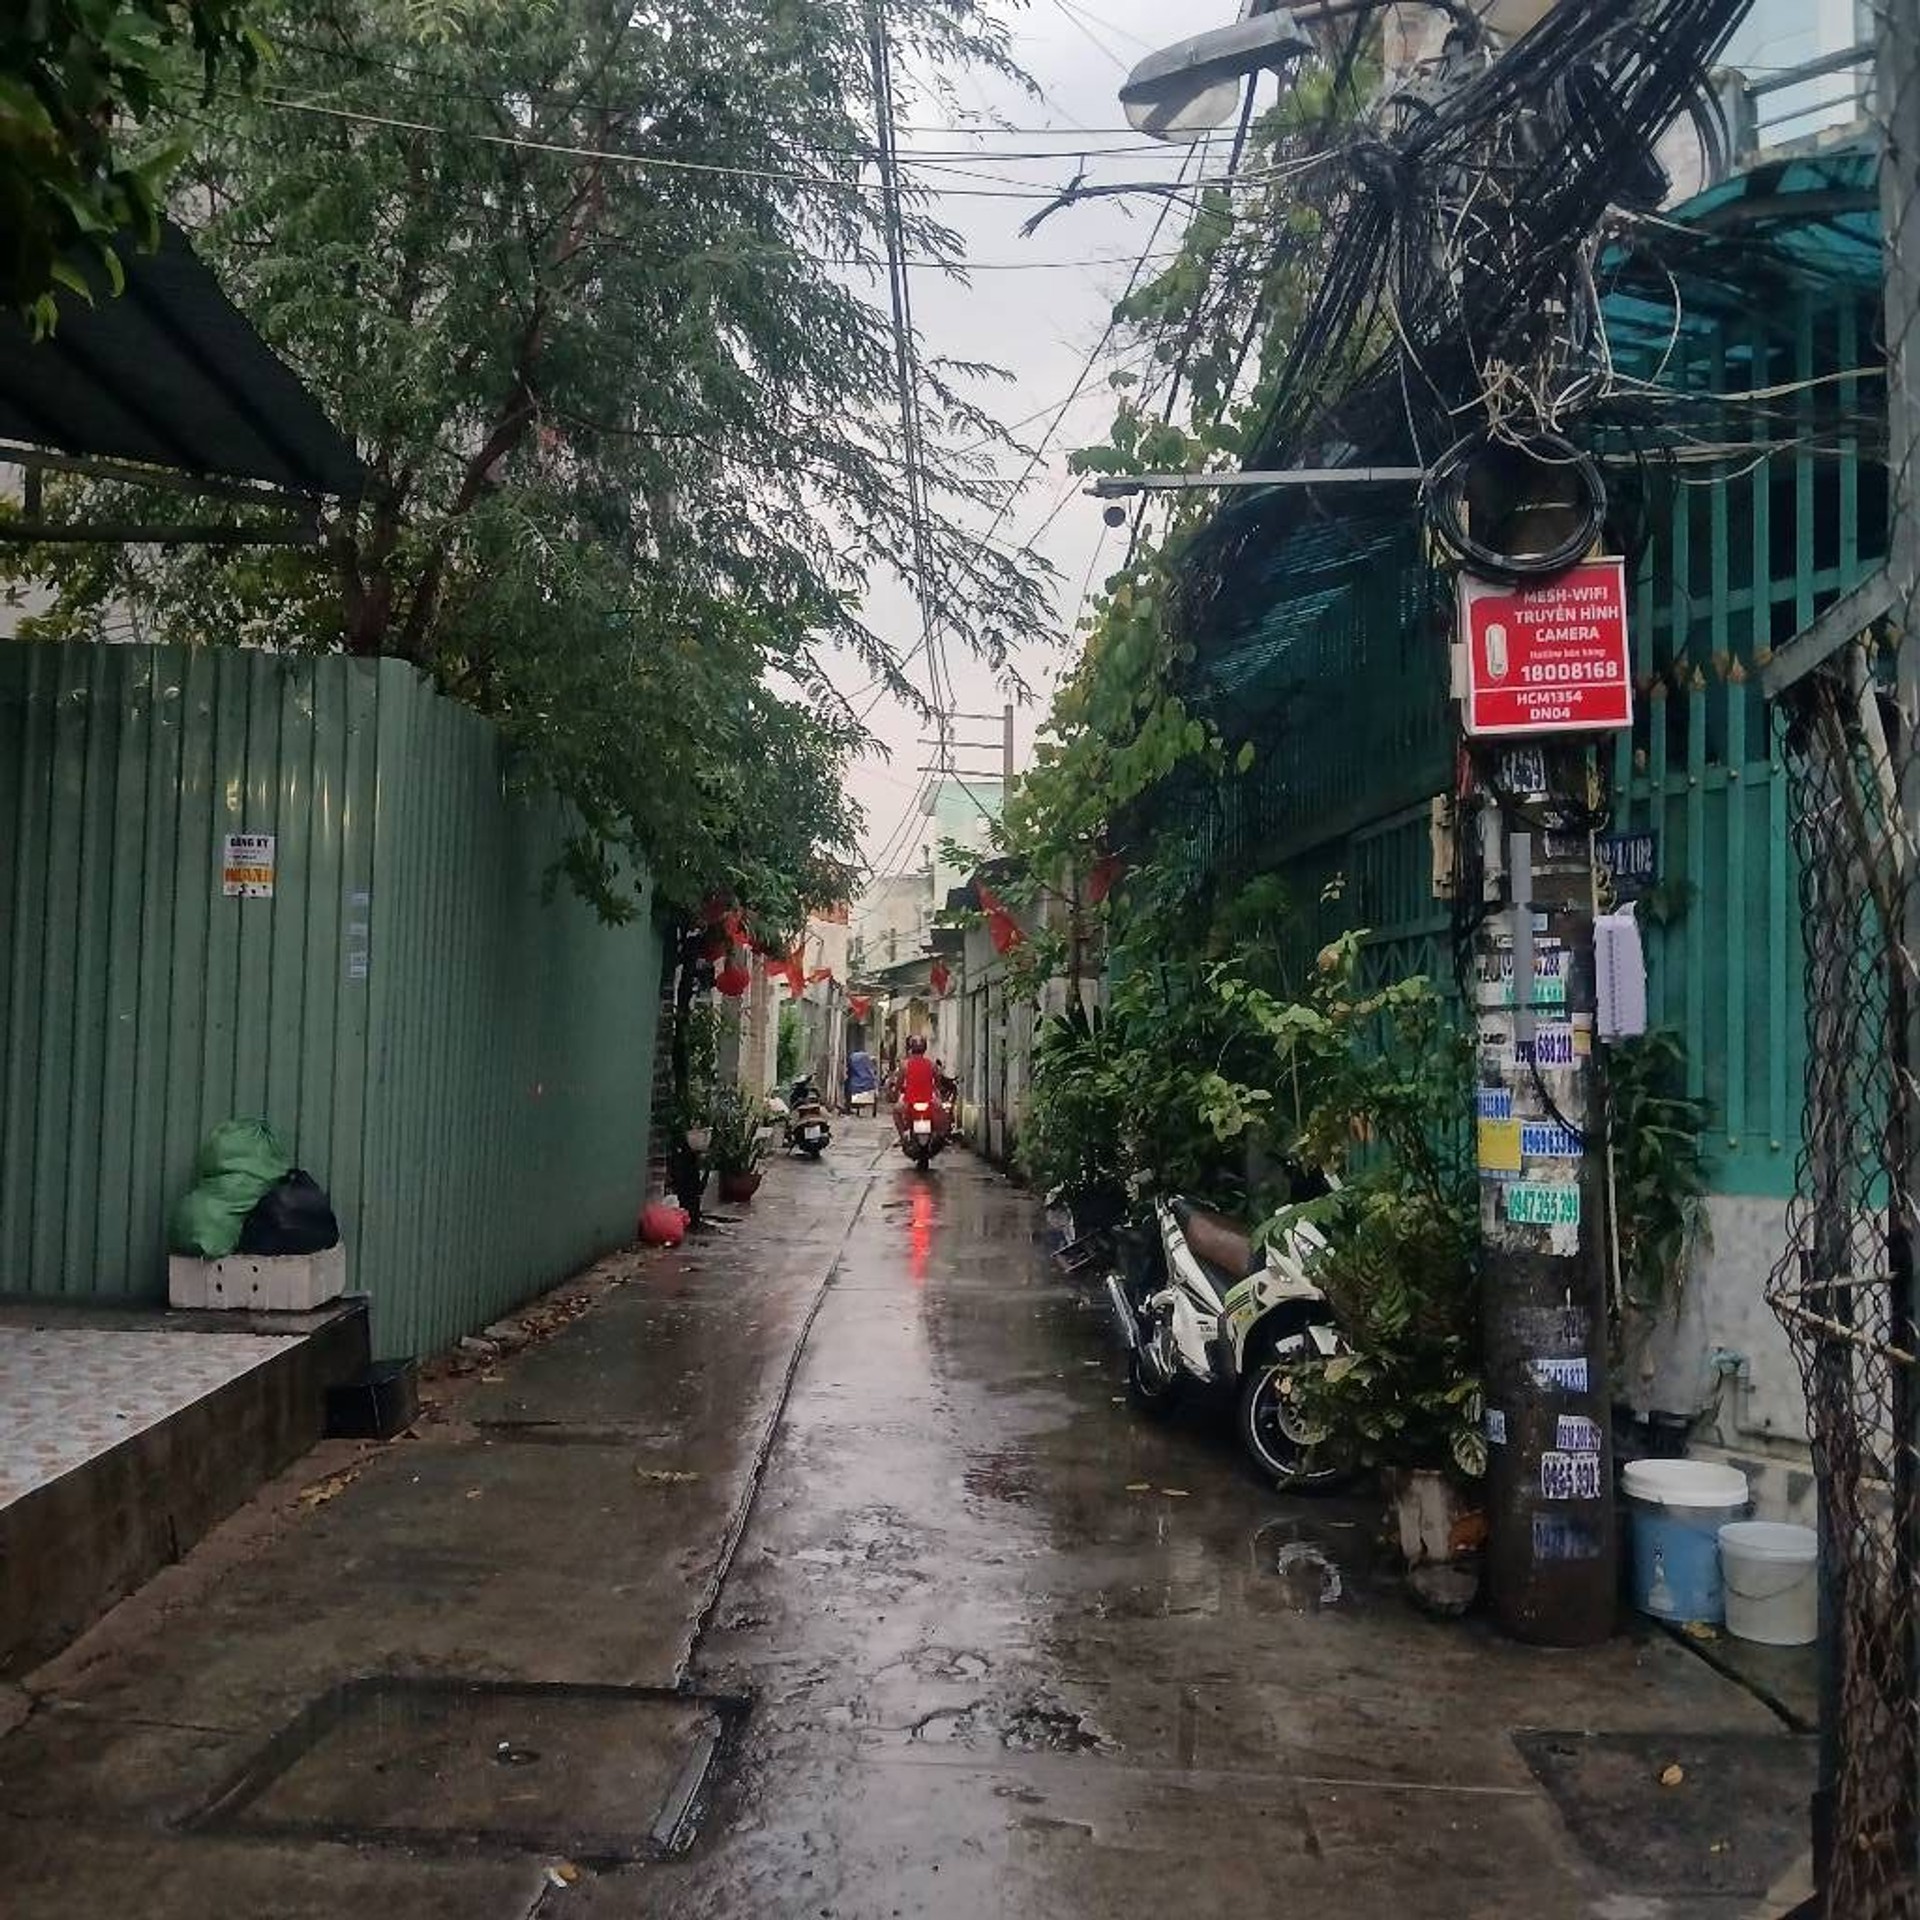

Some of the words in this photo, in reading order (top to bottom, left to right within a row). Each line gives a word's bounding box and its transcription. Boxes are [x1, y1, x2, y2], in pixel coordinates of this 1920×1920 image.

[1523, 586, 1608, 604] MESH-WIFI
[1580, 605, 1619, 621] HÌNH
[1535, 626, 1600, 643] CAMERA
[1521, 661, 1618, 683] 18008168
[1516, 690, 1583, 706] HCM1354
[1530, 706, 1571, 720] DN04
